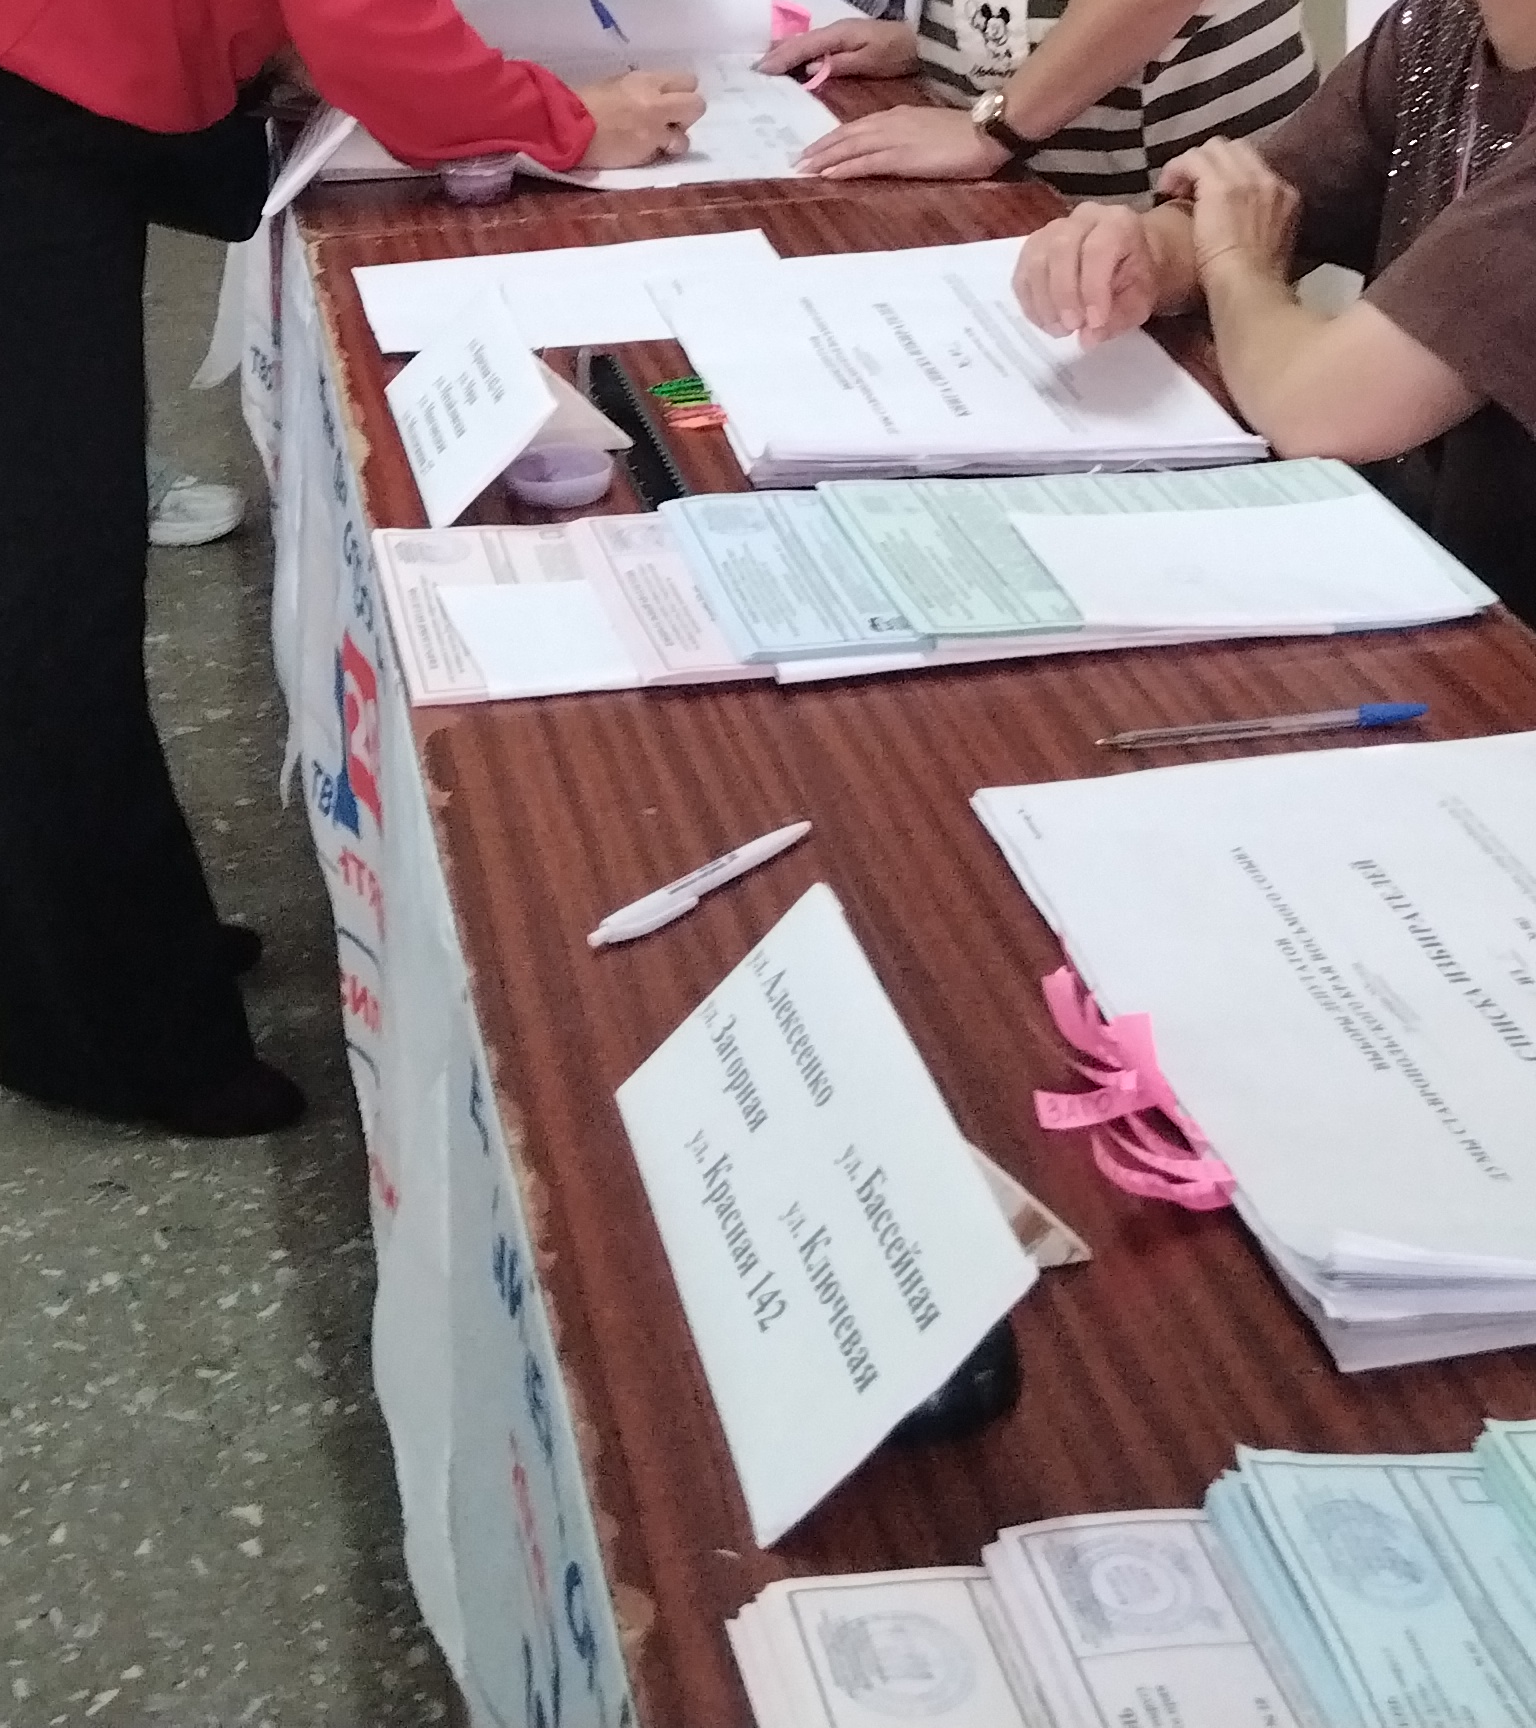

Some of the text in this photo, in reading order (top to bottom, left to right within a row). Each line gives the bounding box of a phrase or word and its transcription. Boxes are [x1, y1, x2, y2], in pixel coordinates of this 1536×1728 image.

[1349, 859, 1471, 984] ИЗБИРАТЕЛЕЙ
[701, 1152, 760, 1278] Красная
[745, 1270, 788, 1334] 142
[711, 1014, 768, 1133] Загорная
[777, 1200, 807, 1239] ул.
[798, 1225, 879, 1394] Ключевая
[761, 969, 834, 1107] Алексеенко
[833, 1143, 863, 1182] ул.
[856, 1166, 941, 1333] Бассейная
